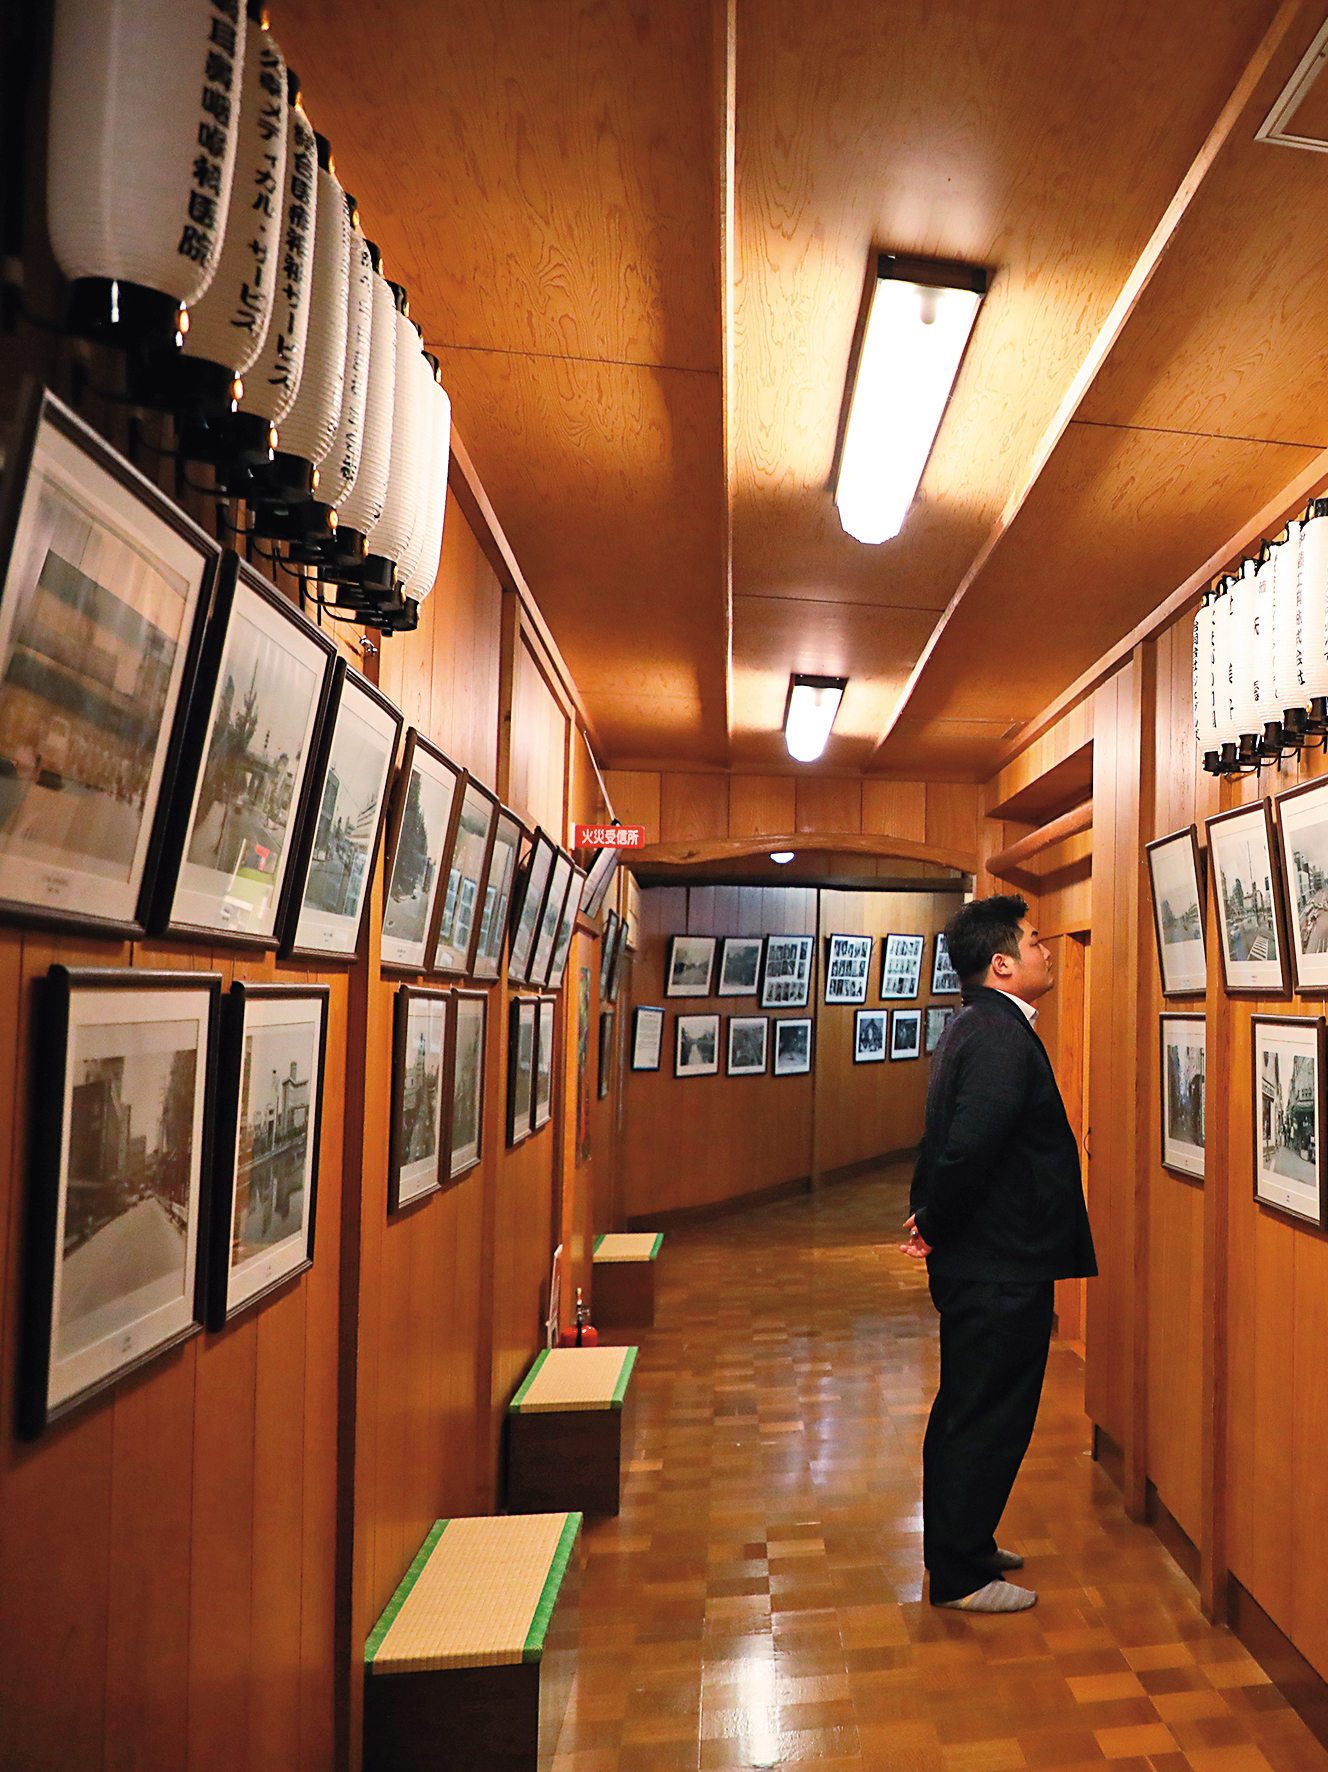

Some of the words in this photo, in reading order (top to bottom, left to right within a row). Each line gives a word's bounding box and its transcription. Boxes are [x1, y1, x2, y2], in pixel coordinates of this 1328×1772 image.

[581, 829, 639, 846] 火災受信所
